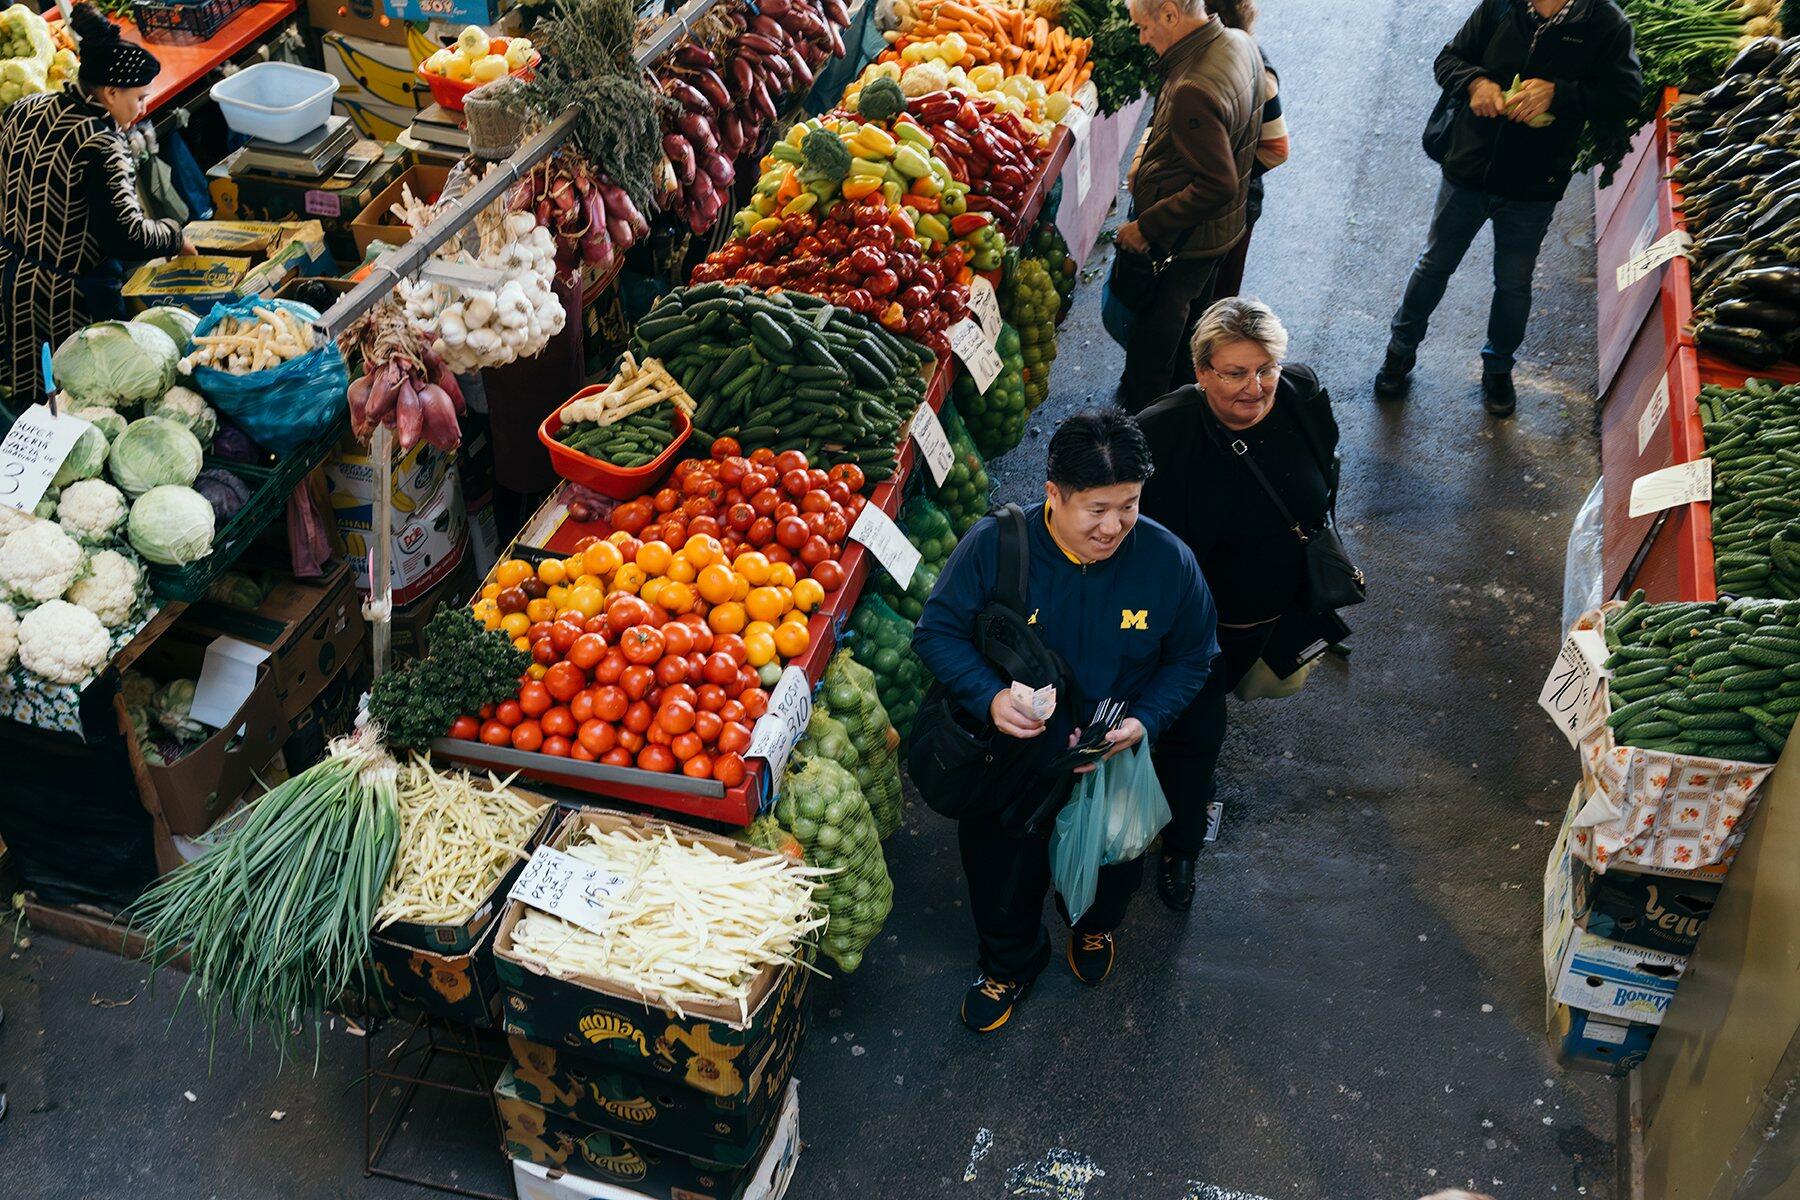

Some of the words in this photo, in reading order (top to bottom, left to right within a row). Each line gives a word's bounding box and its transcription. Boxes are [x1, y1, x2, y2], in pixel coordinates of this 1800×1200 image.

[0, 462, 25, 495] 3
[403, 525, 423, 547] Dole
[1120, 608, 1149, 630] M
[1548, 665, 1585, 713] 10
[1612, 944, 1668, 964] PREMIUM
